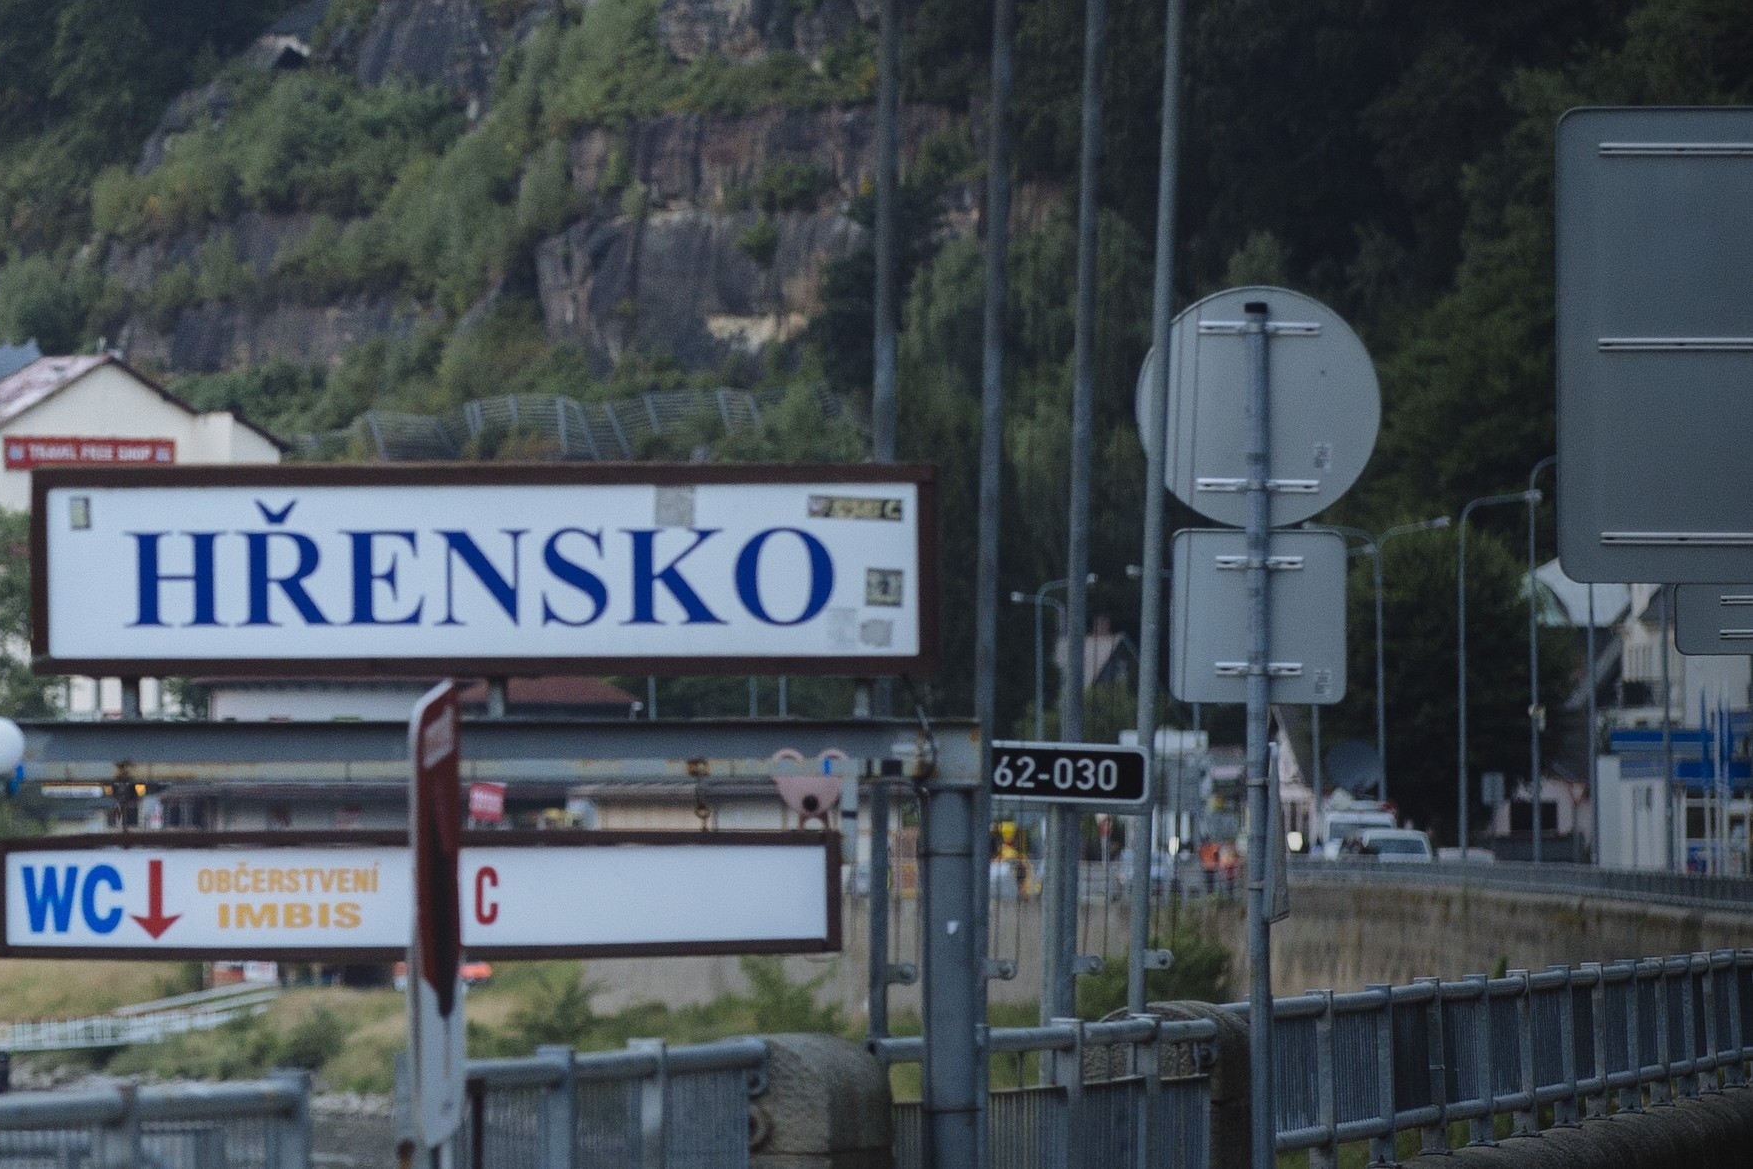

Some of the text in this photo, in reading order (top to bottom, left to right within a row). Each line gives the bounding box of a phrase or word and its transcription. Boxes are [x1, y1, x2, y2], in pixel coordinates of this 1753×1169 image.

[28, 443, 152, 462] TRAVEL FREE SHOP
[124, 498, 835, 628] HŘENSKO
[993, 755, 1119, 792] 62-030
[197, 860, 380, 894] OBČERSTVENÍ
[20, 864, 124, 934] WC
[217, 901, 363, 930] IMBIS
